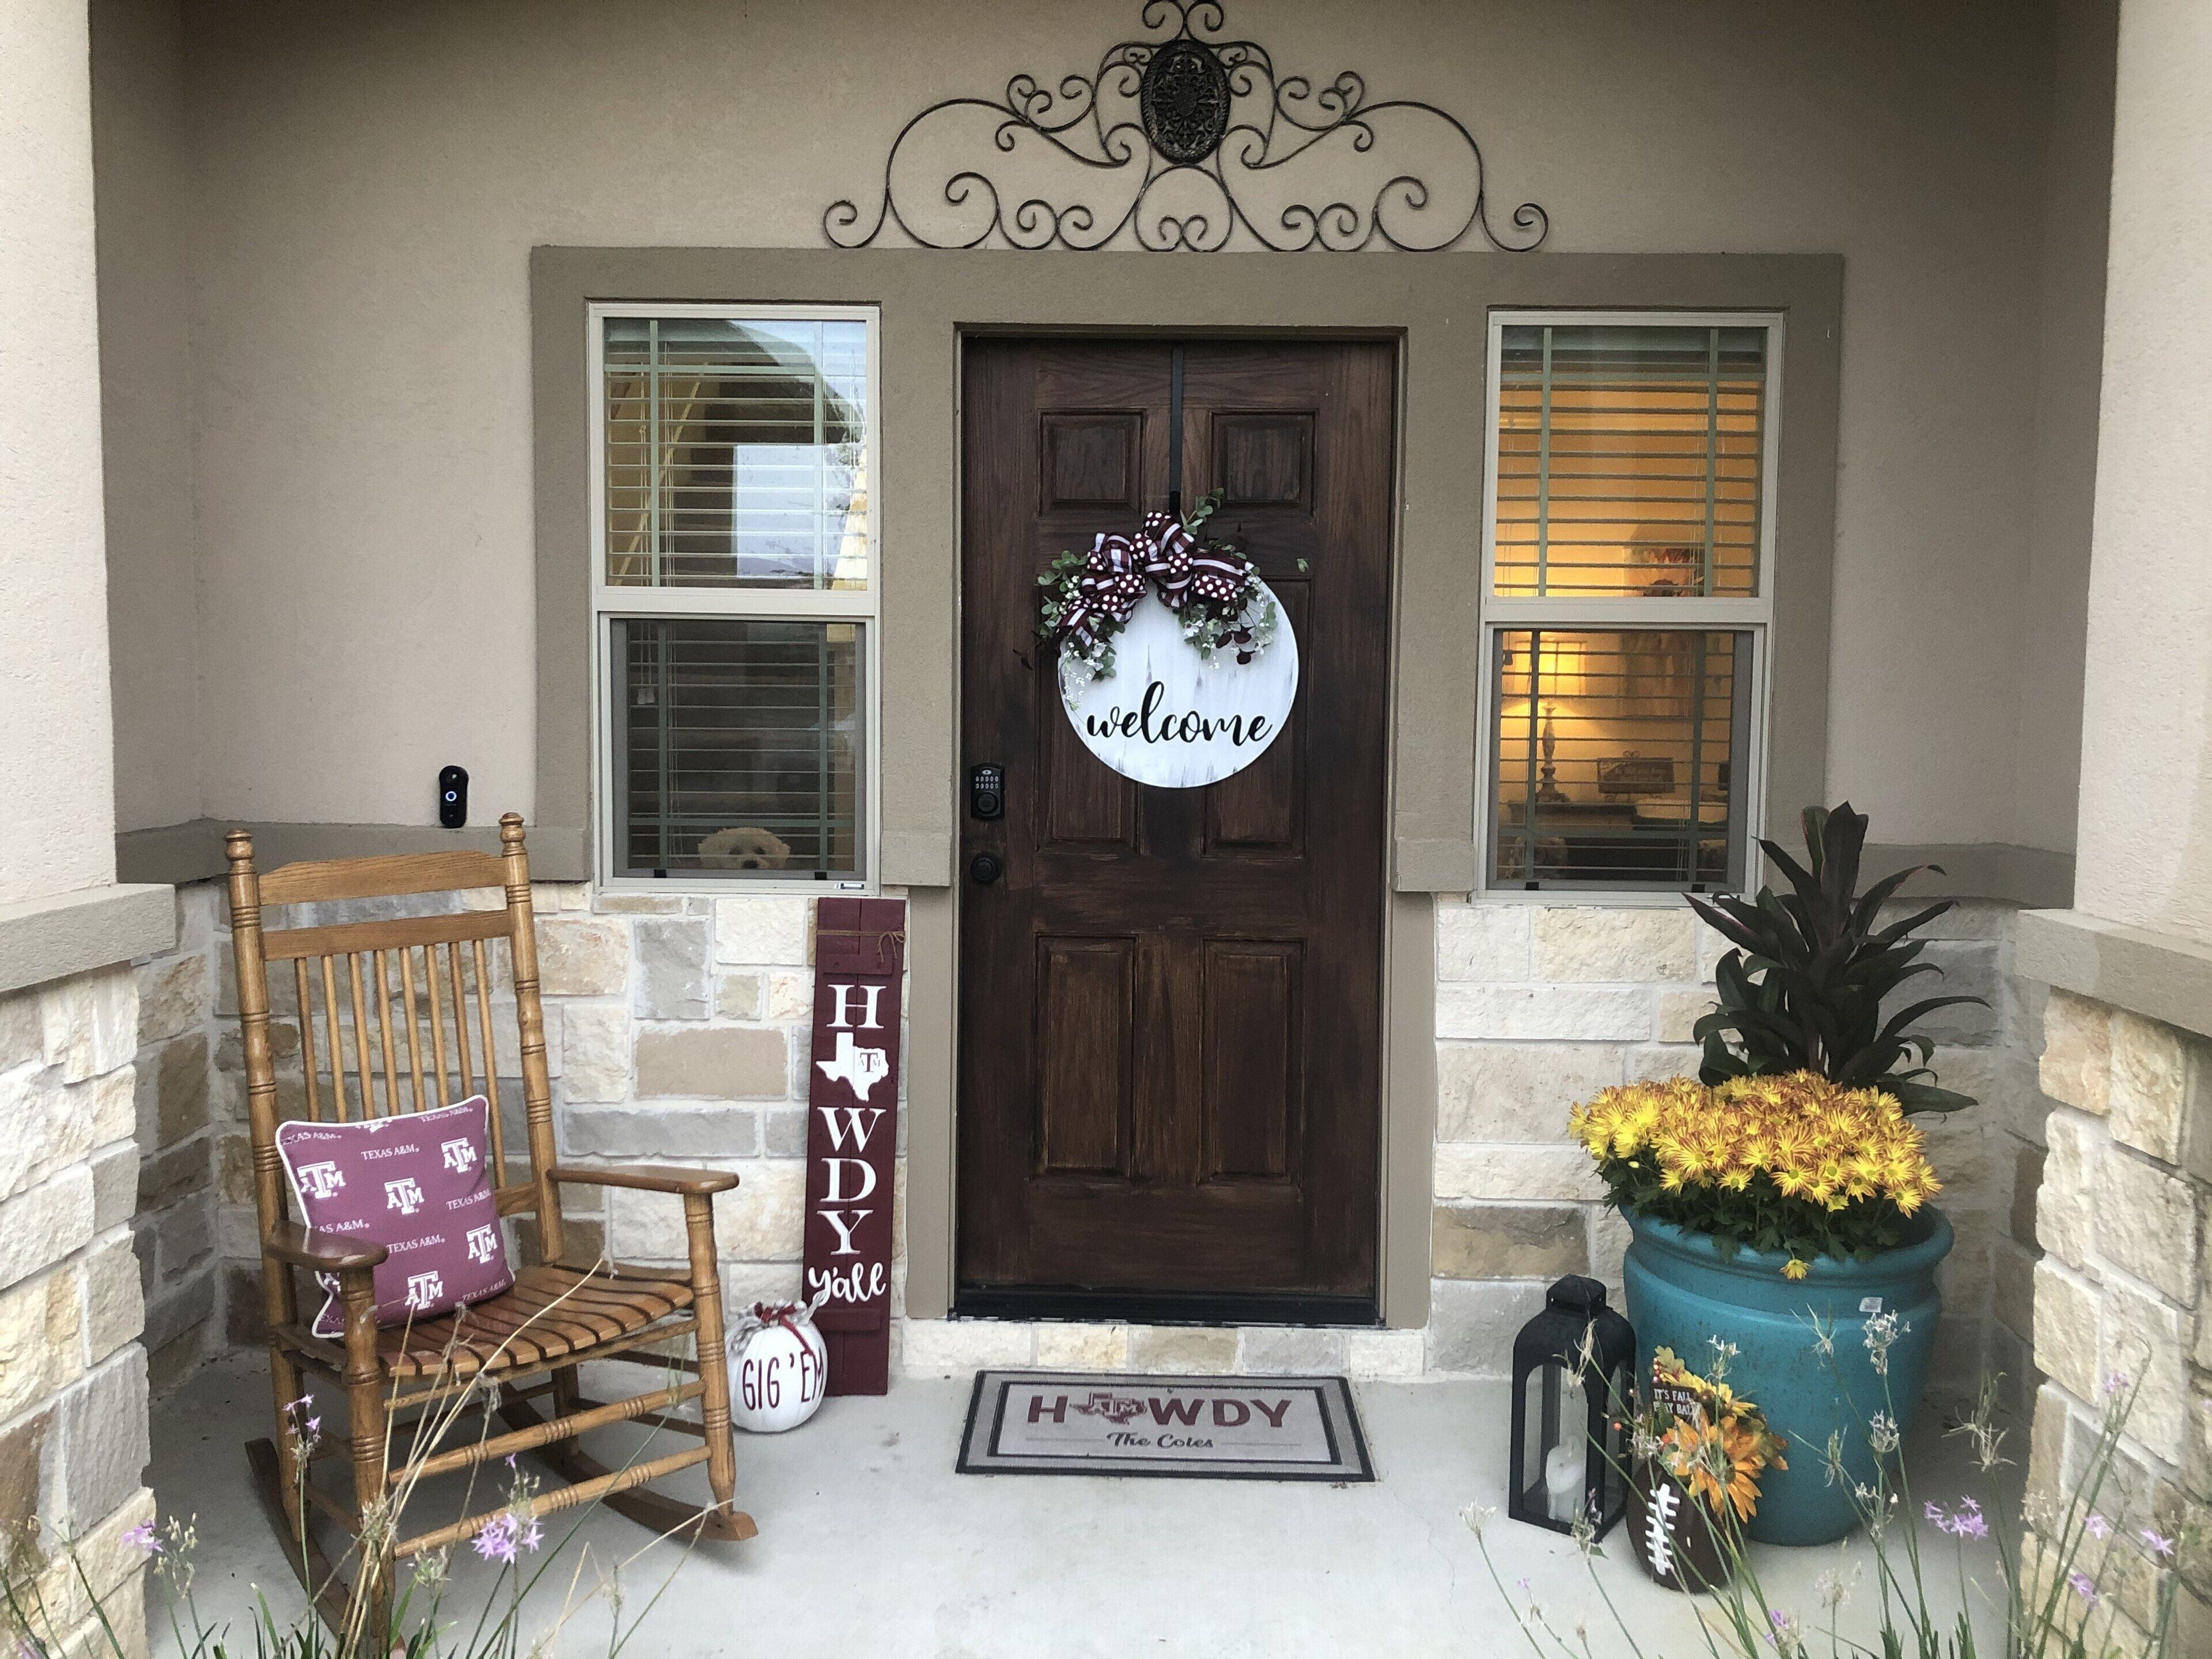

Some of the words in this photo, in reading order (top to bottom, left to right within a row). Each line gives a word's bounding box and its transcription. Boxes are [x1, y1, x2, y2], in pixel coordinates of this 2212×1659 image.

[1086, 681, 1272, 746] welcome
[361, 1147, 392, 1161] TEXAS
[445, 1195, 473, 1210] TEXAS
[386, 1239, 418, 1254] TEXAS
[461, 1287, 487, 1302] TEXAS
[742, 1357, 781, 1411] GIG
[1653, 1388, 1670, 1400] IT'S
[1107, 1432, 1151, 1446] The
